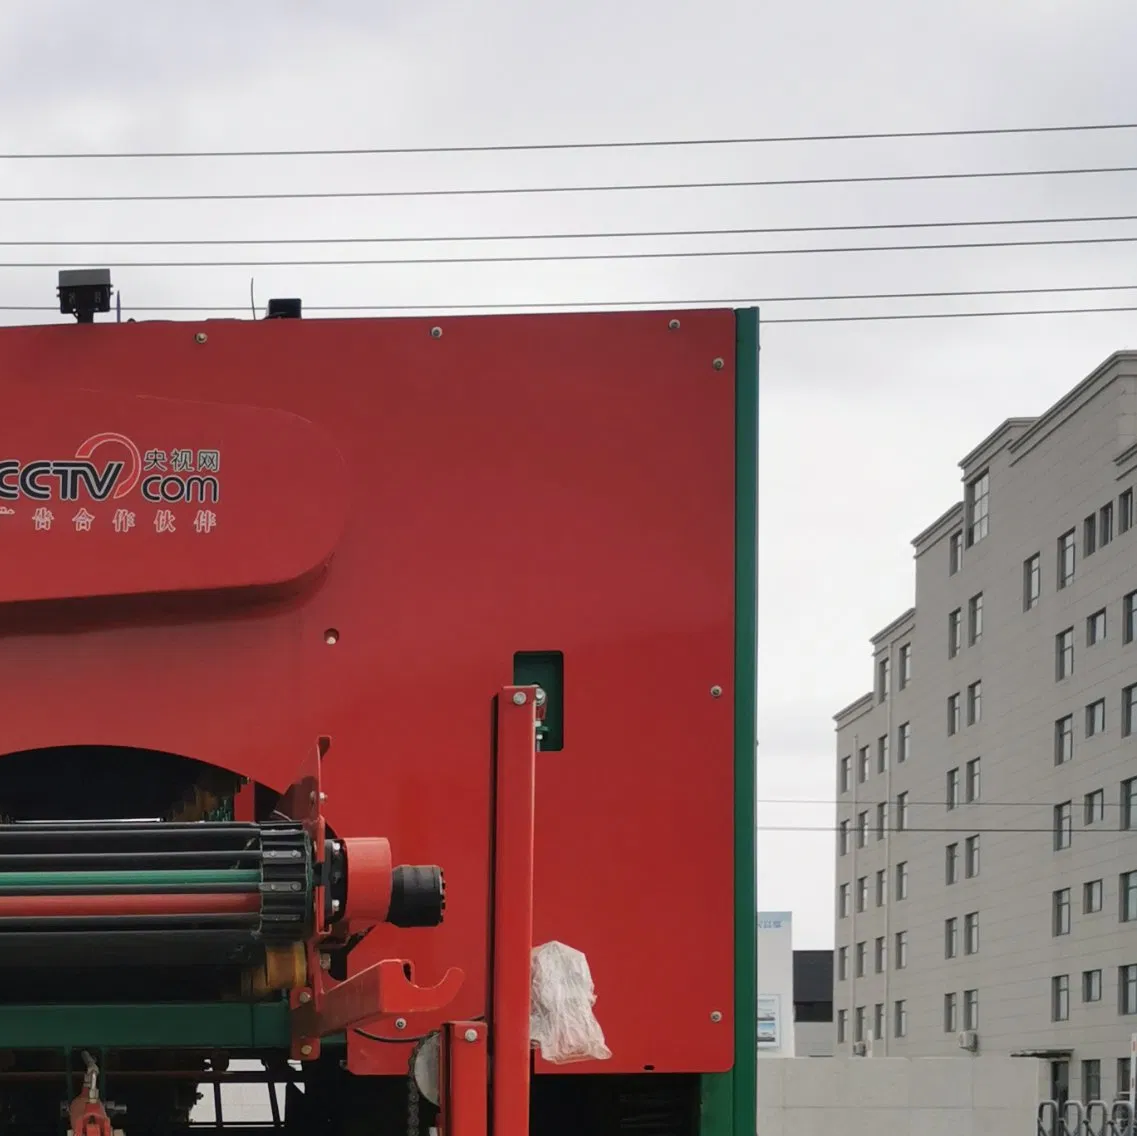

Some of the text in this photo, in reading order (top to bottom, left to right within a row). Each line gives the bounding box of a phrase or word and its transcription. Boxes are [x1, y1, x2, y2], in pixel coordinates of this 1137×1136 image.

[143, 448, 220, 472] 央视网
[141, 474, 220, 503] com
